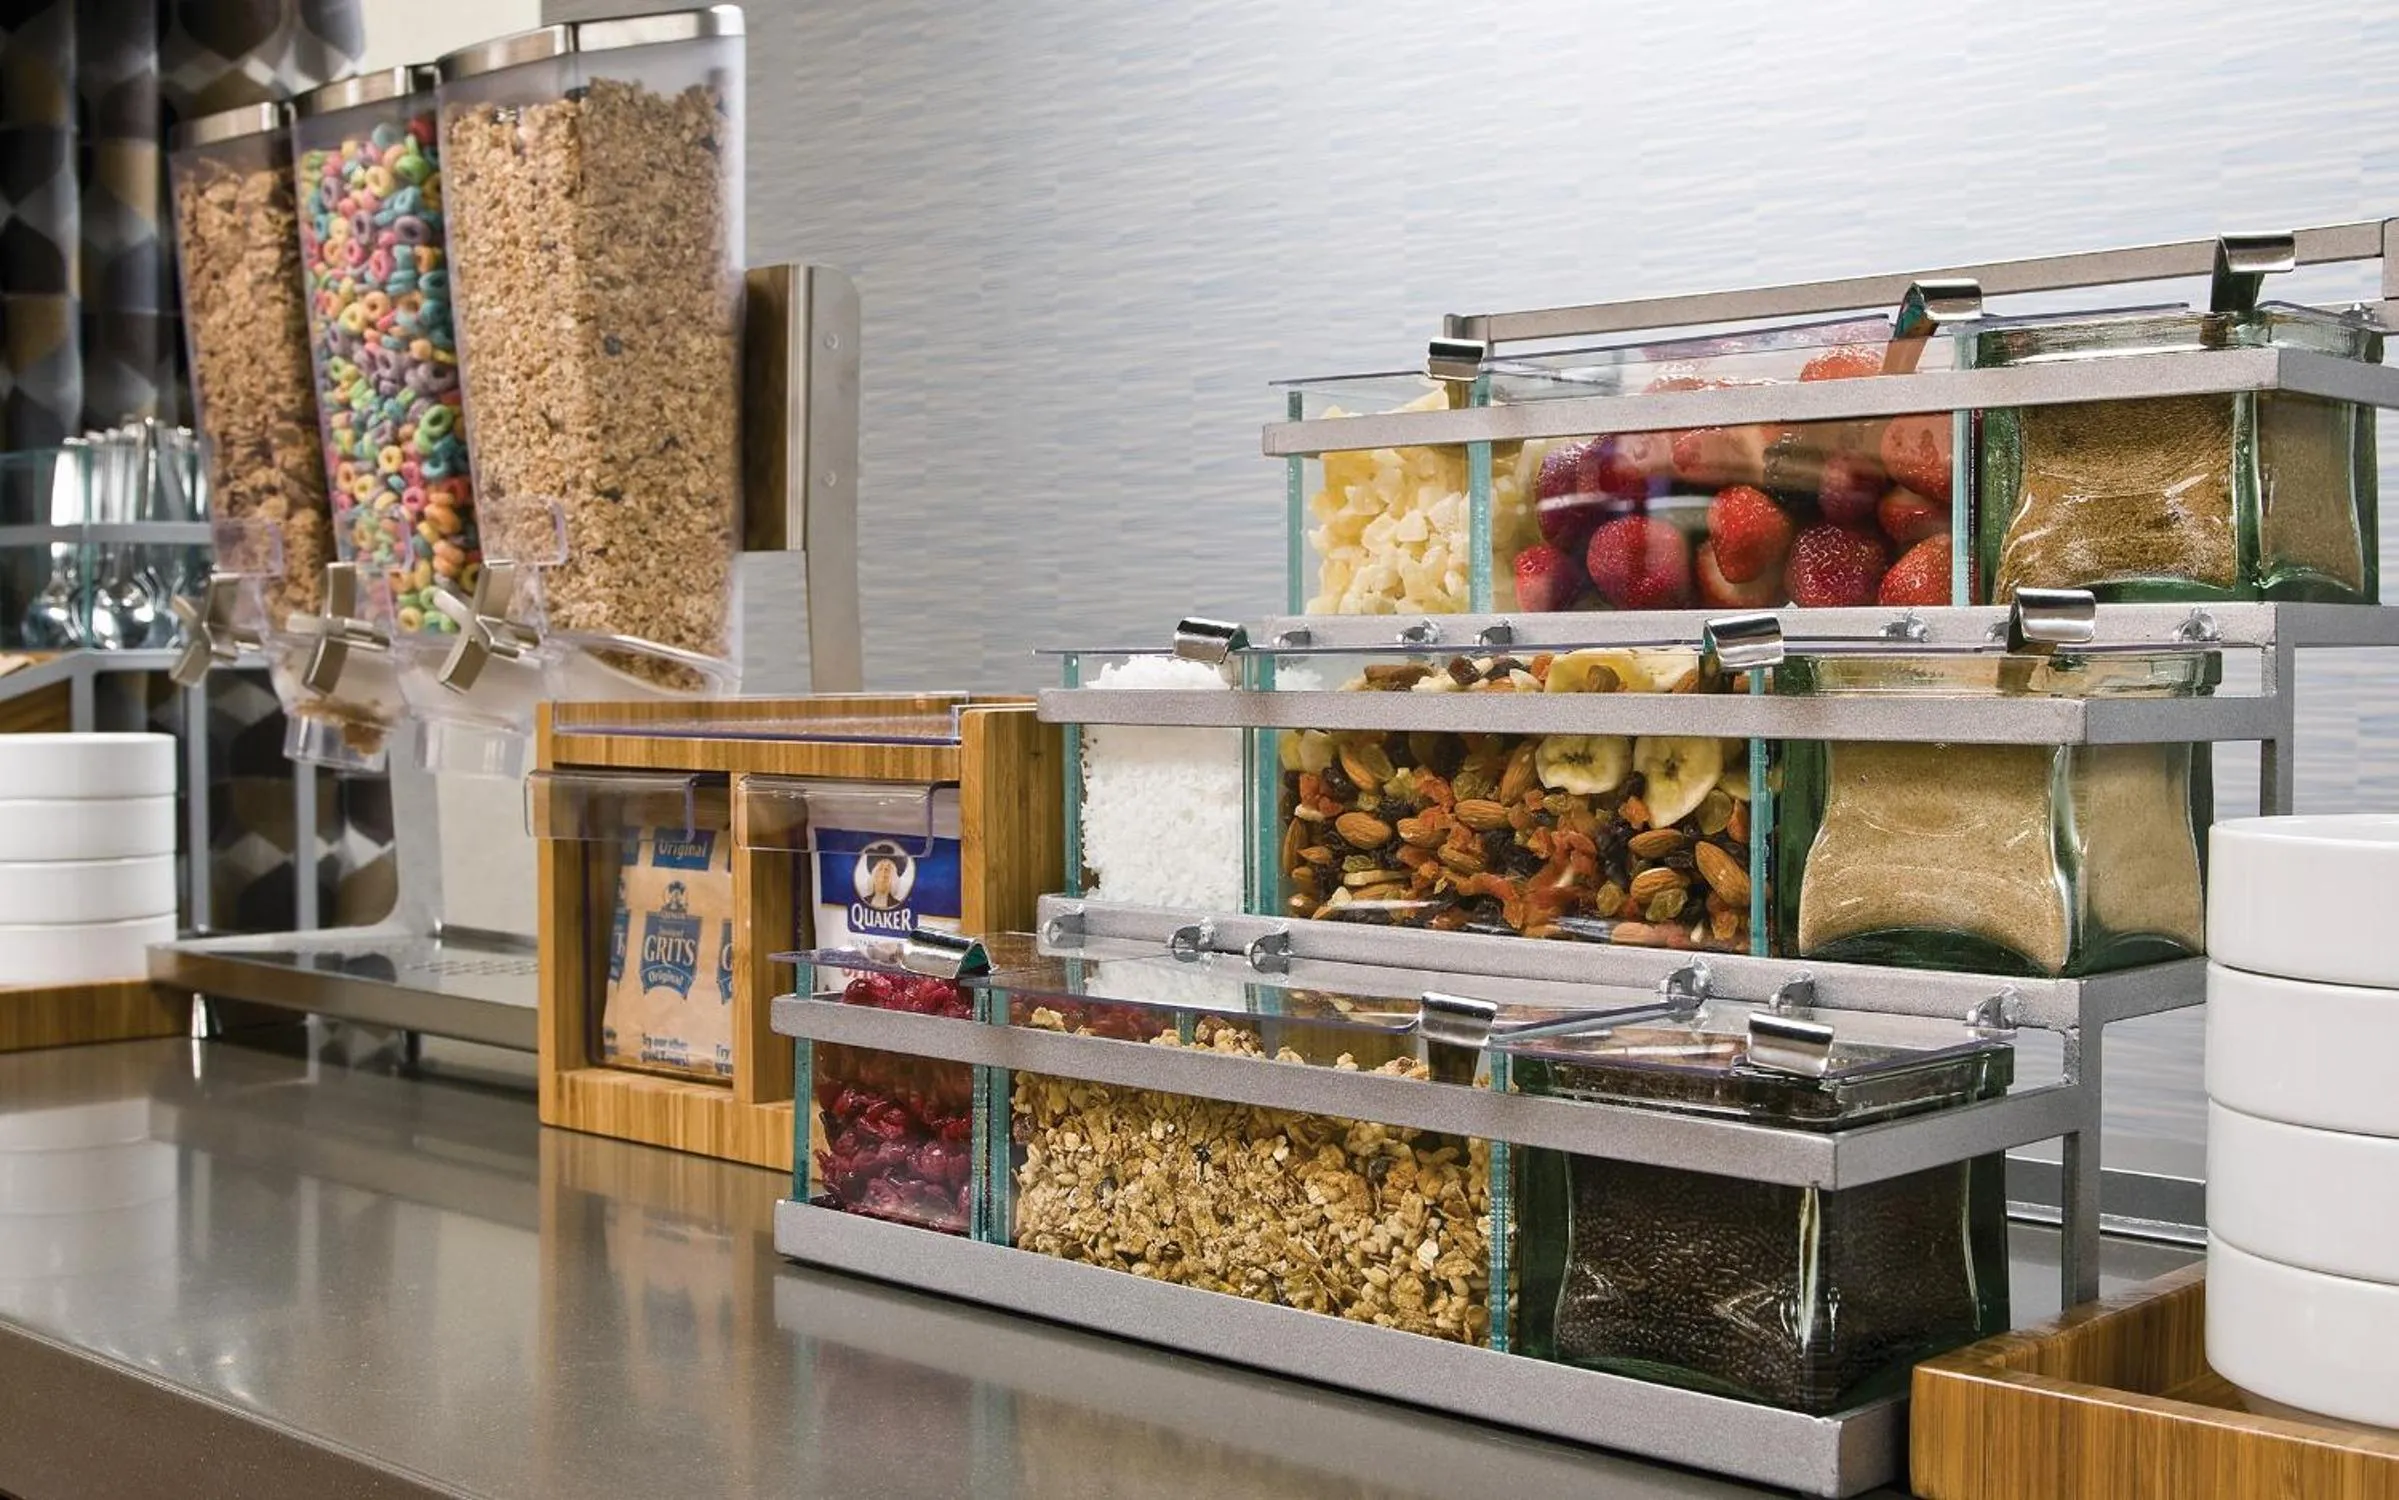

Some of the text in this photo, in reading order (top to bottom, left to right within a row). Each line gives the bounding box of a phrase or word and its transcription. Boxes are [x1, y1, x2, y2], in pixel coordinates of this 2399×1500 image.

[658, 839, 708, 860] Original
[851, 903, 911, 931] QUAKER
[644, 935, 695, 967] GRITS
[648, 970, 685, 986] Original
